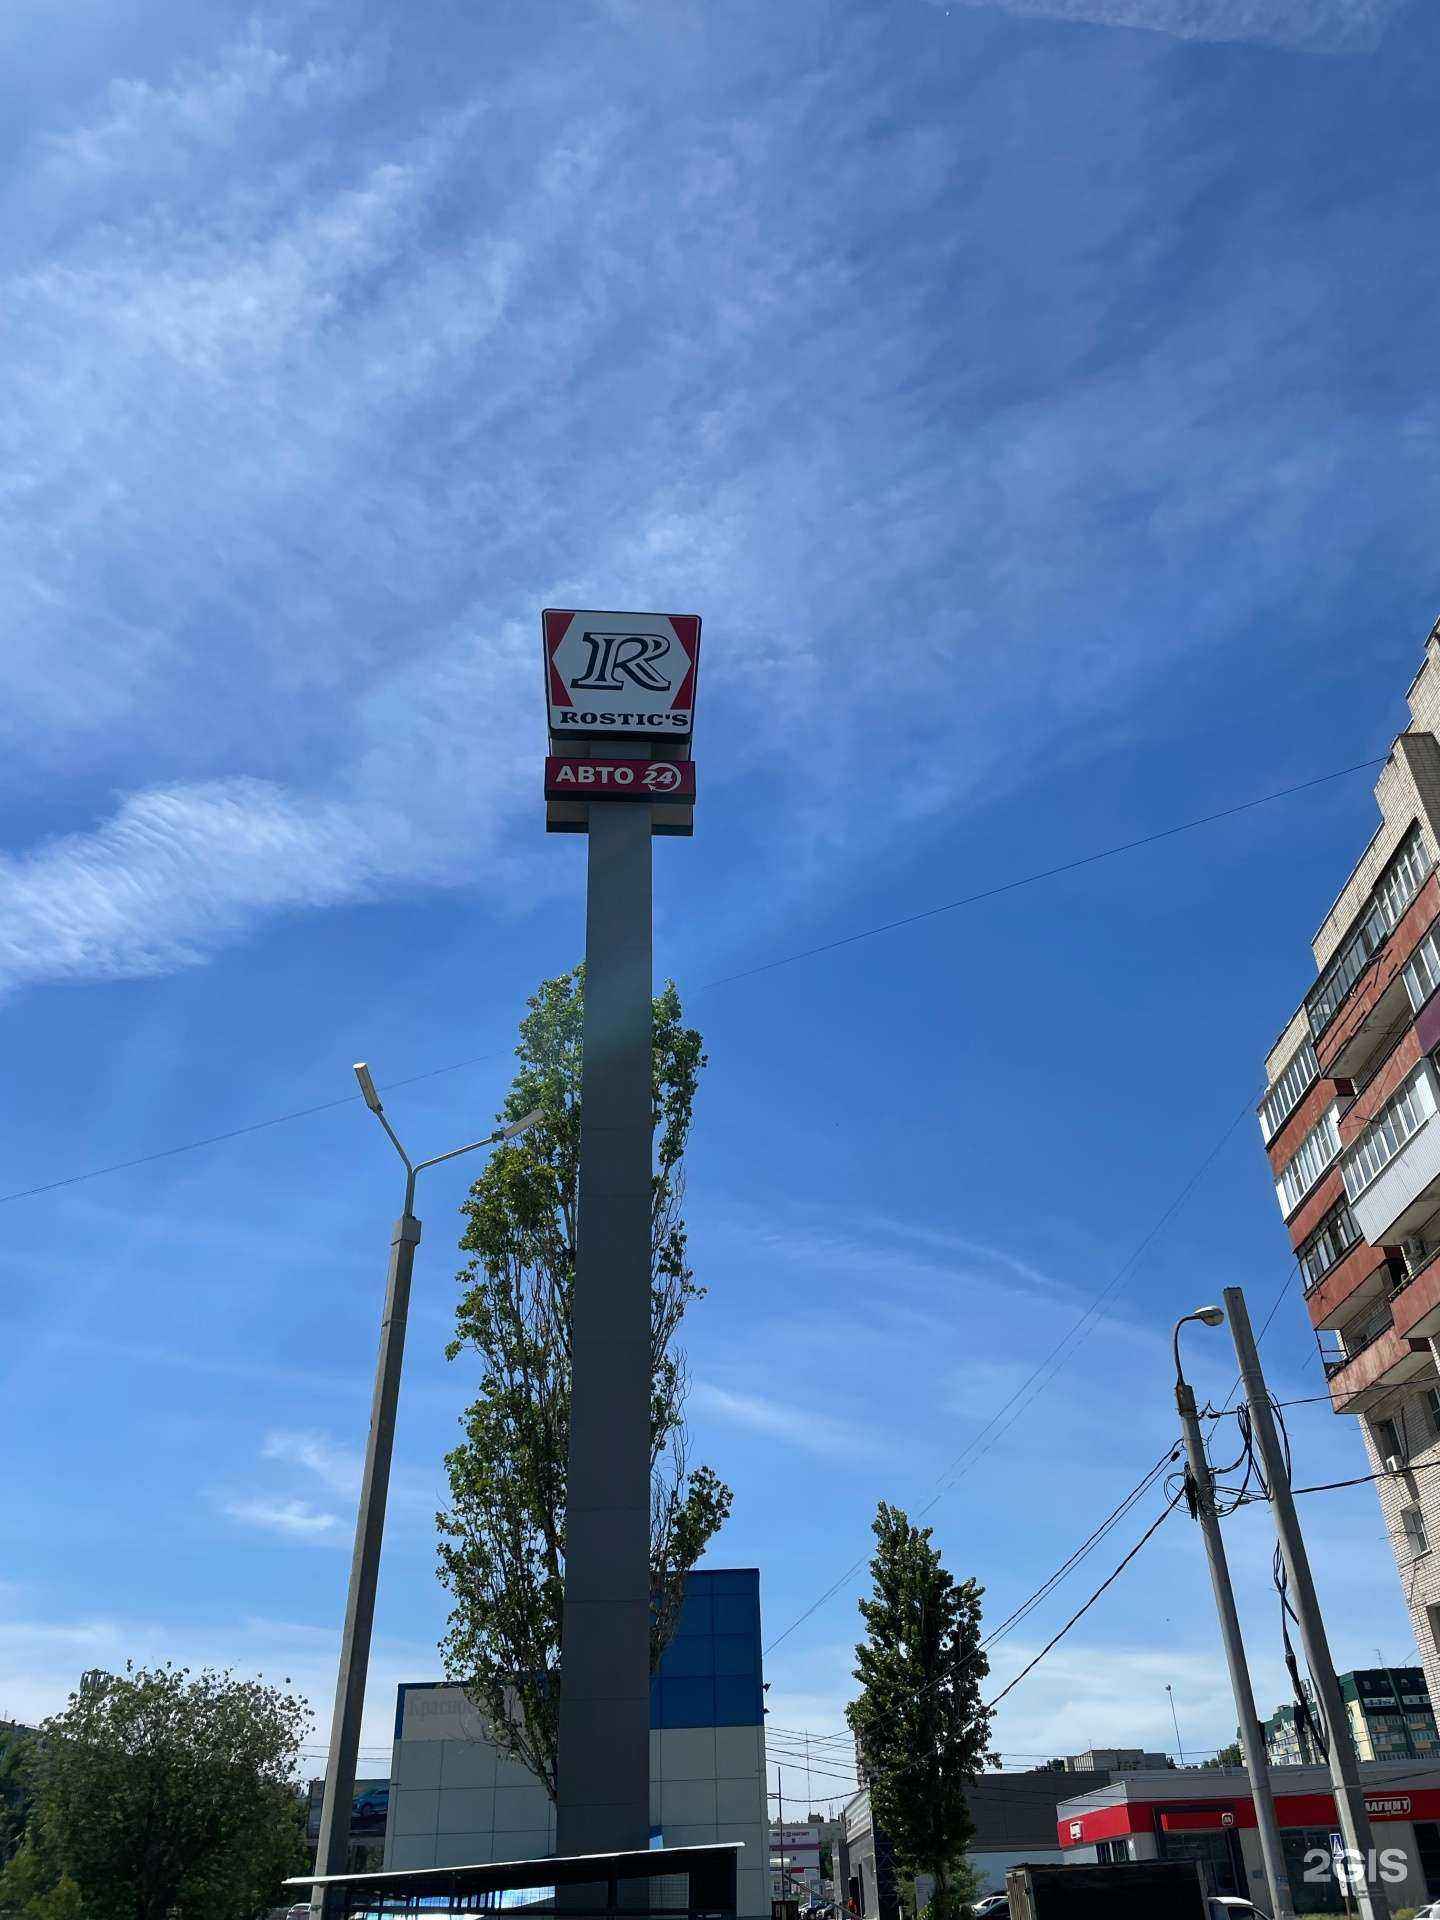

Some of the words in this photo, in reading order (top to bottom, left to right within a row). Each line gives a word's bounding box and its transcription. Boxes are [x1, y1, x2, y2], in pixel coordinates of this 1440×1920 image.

[559, 710, 690, 728] ROSTIC'S
[555, 765, 635, 785] АВТО
[640, 769, 674, 785] 24
